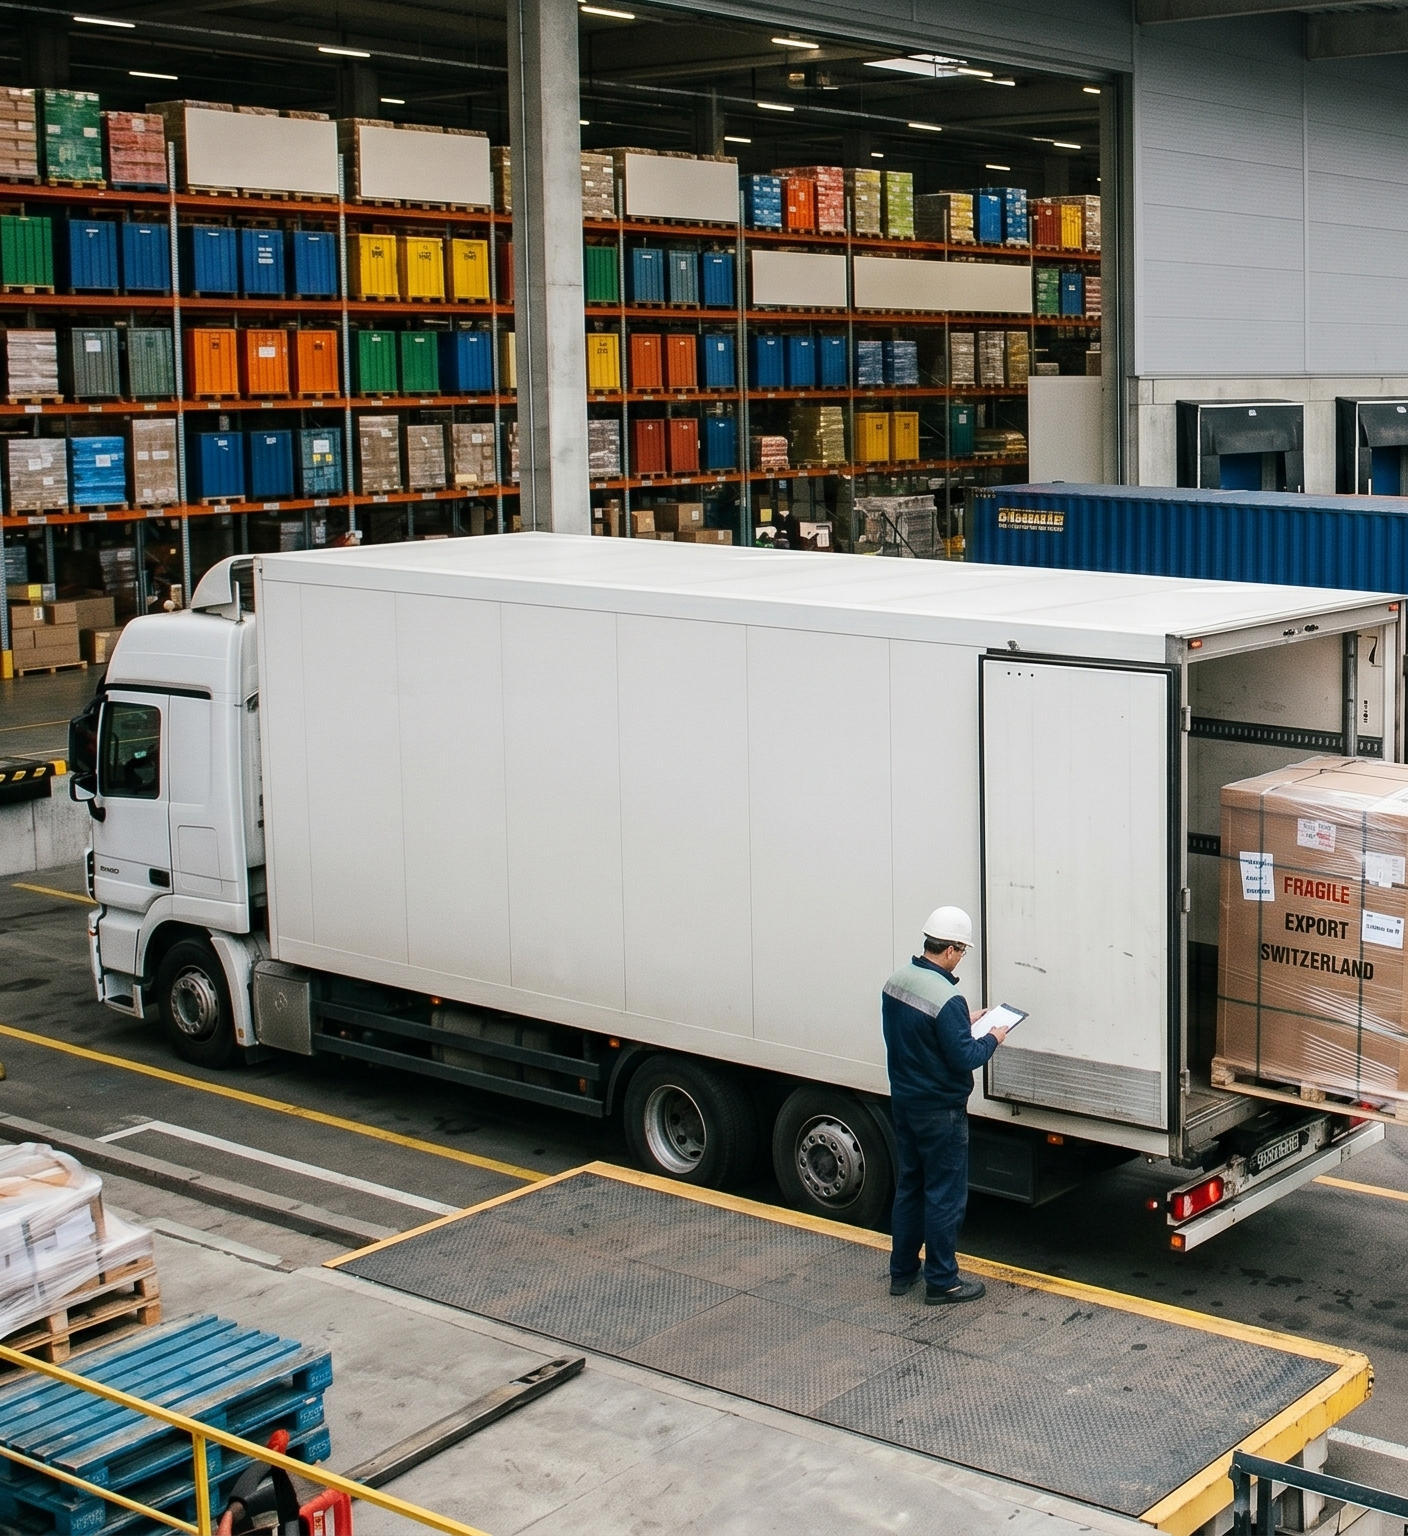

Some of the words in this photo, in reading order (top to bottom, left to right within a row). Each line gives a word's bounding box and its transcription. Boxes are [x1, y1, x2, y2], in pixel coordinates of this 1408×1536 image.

[1284, 876, 1350, 904] FRAGILE
[1285, 912, 1349, 939] EXPORT
[1261, 943, 1374, 980] SWITZERLAND
